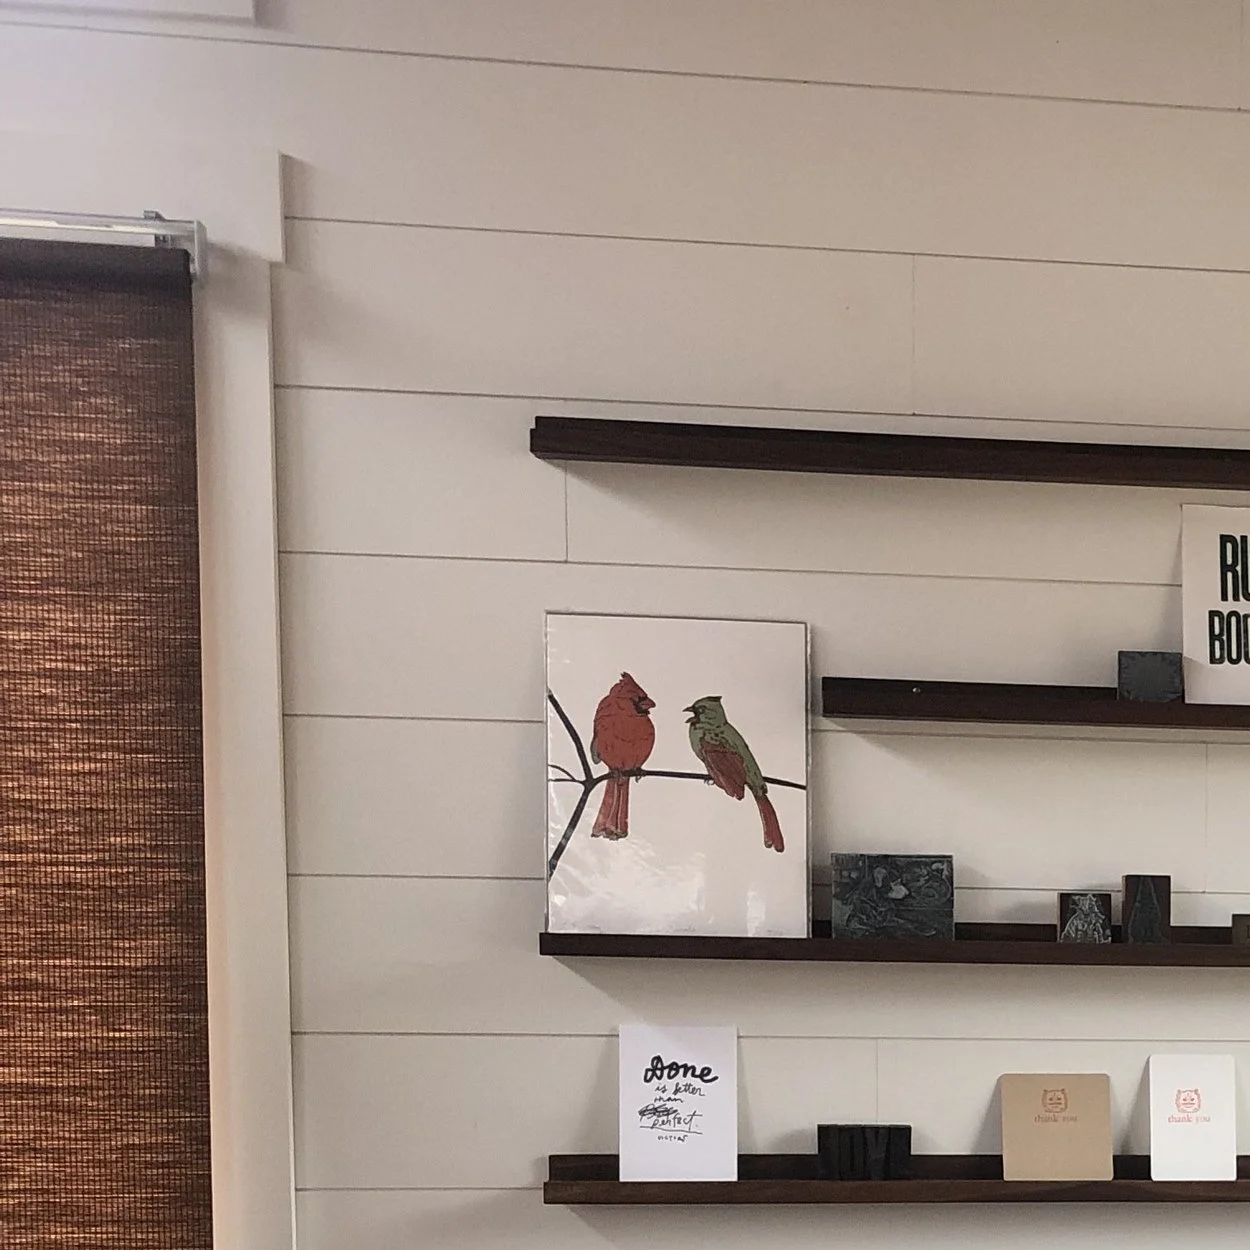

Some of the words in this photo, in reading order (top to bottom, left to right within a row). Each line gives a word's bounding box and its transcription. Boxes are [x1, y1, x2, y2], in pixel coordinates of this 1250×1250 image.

[643, 1054, 719, 1083] Done
[655, 1083, 667, 1094] is
[672, 1082, 705, 1097] better
[1168, 1113, 1192, 1123] thank
[1195, 1115, 1211, 1125] you
